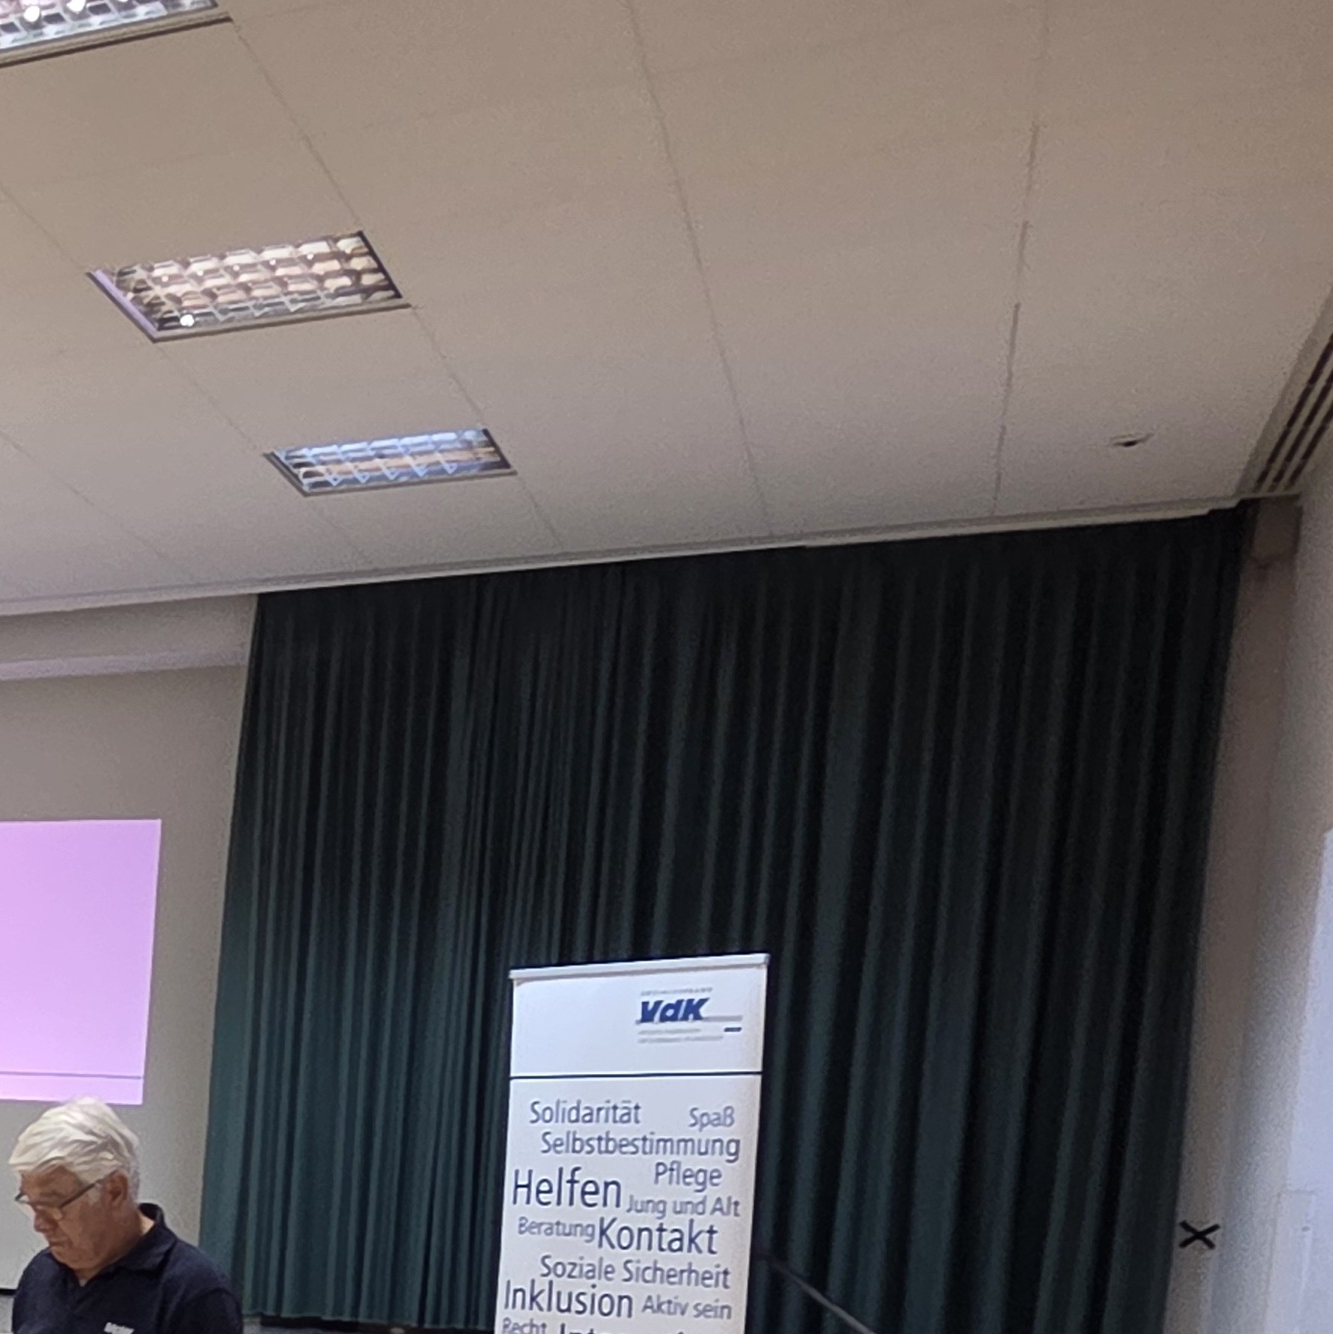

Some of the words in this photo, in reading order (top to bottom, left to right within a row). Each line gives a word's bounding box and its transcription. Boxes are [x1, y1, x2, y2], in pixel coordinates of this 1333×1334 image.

[640, 997, 711, 1023] VdK
[529, 1099, 642, 1125] Solidarität
[688, 1106, 735, 1132] Spaß
[540, 1131, 741, 1163] Selbstbestimmung
[512, 1167, 622, 1208] Helfen
[654, 1162, 723, 1192] Pflege
[626, 1196, 667, 1219] Jung
[672, 1197, 706, 1216] und
[710, 1197, 741, 1217] Alt
[518, 1217, 595, 1244] Beratung
[597, 1217, 718, 1254] Kontakt
[539, 1255, 616, 1281] Soziale
[623, 1260, 730, 1290] Sicherheit
[504, 1279, 633, 1319] Inklusion
[641, 1295, 688, 1317] Aktiv
[693, 1297, 732, 1320] sein
